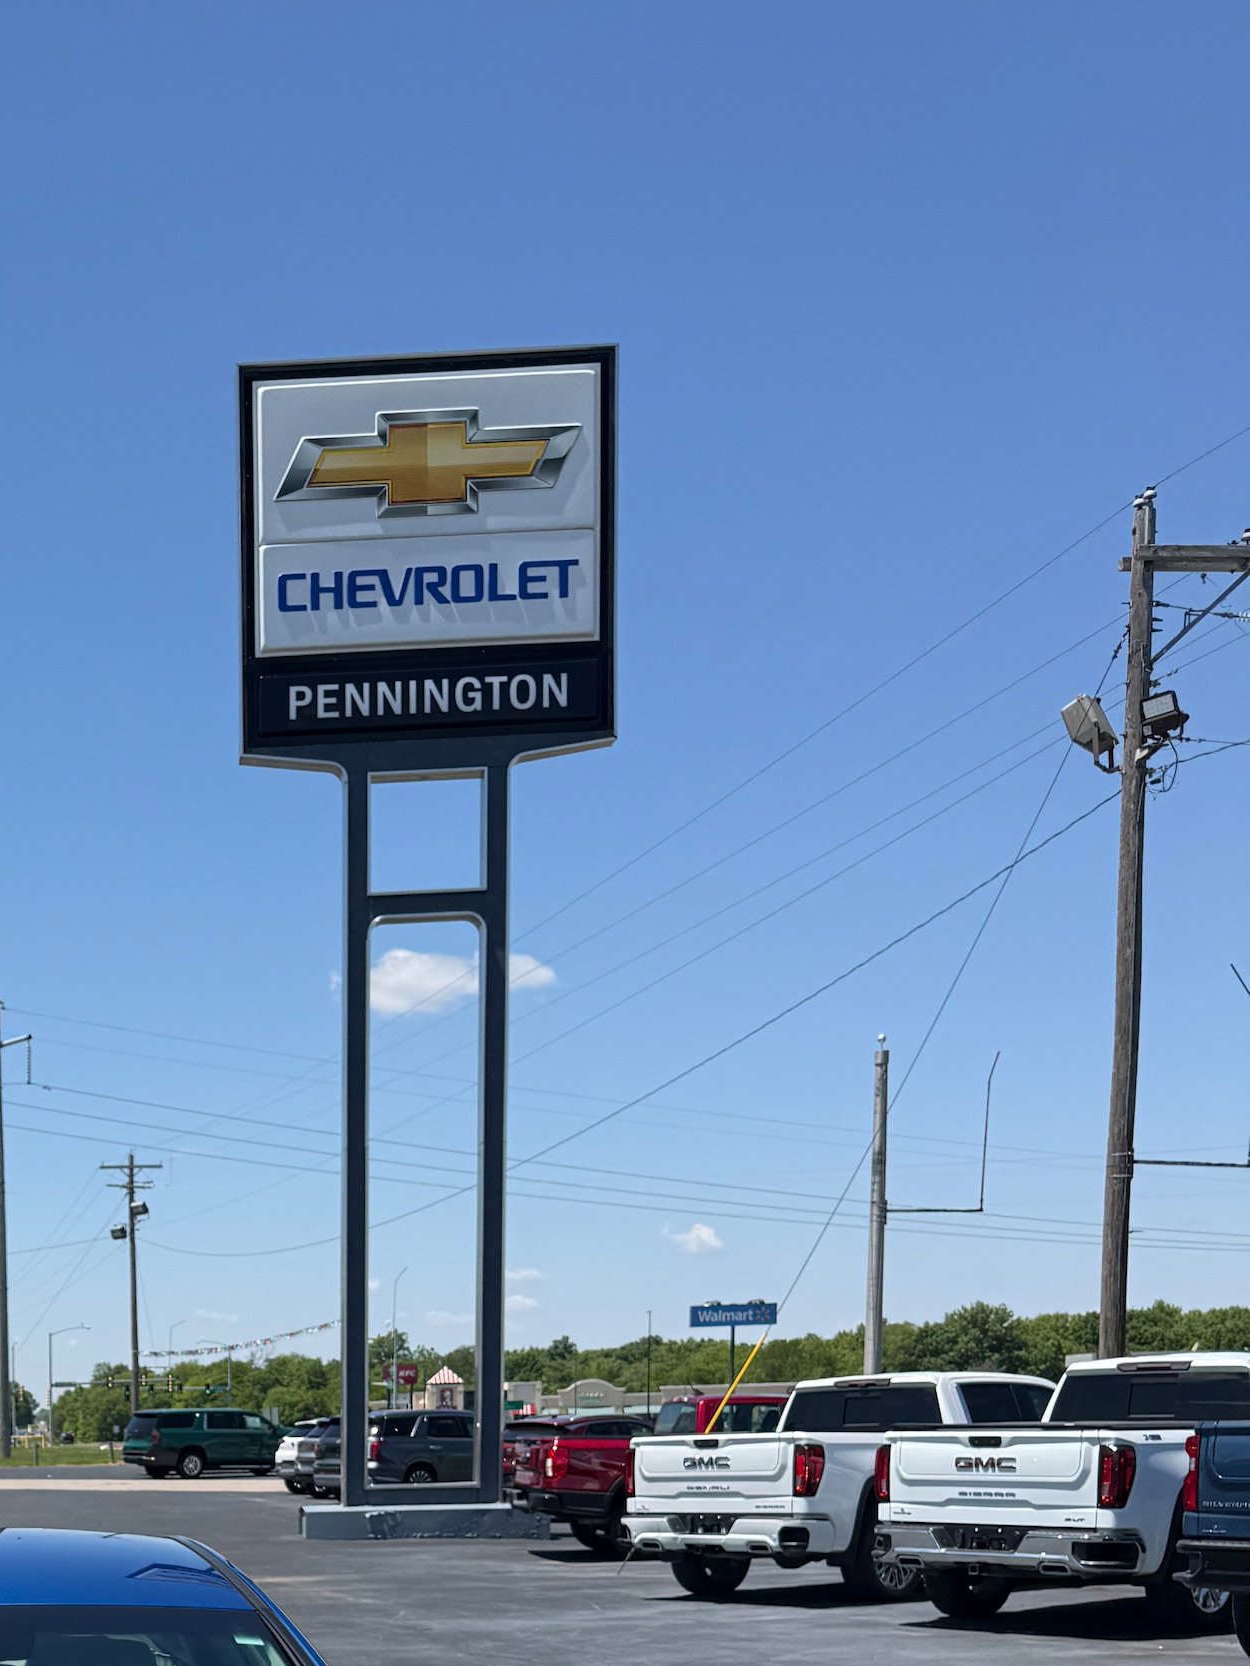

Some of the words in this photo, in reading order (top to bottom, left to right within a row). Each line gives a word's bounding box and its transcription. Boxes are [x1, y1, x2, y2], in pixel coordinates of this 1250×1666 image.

[277, 559, 579, 612] CHEVROLET
[288, 672, 568, 721] PENNINGTON
[697, 1309, 755, 1322] Walmart
[398, 1369, 416, 1377] KFC
[683, 1456, 731, 1470] GMC
[955, 1457, 1017, 1473] GMC
